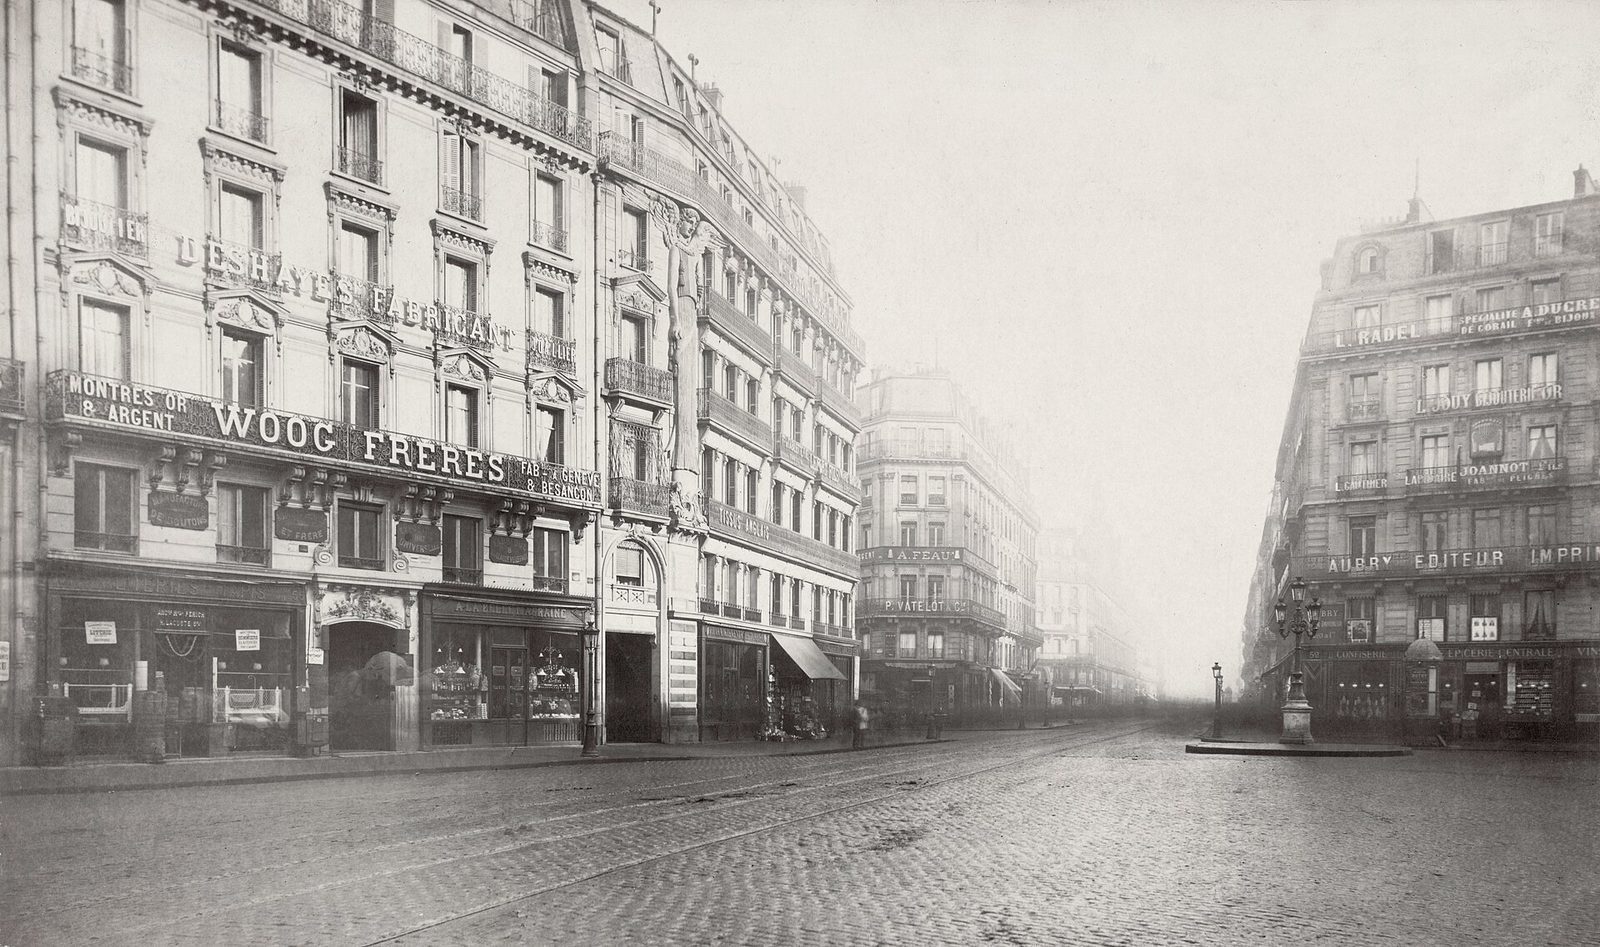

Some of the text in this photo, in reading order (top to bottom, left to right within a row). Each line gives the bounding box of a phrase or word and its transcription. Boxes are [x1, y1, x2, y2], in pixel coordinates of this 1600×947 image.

[180, 233, 352, 305] DESHAYES
[372, 286, 516, 351] FABRICANT
[1358, 324, 1420, 345] RADEL
[70, 375, 188, 414] MONTRES OR
[82, 400, 175, 432] & ARGENT
[210, 401, 504, 482] WOOG FRERES
[527, 478, 535, 492] &
[1327, 555, 1392, 574] AUBRY
[1414, 550, 1505, 570] EDITEUR
[897, 601, 944, 612] VATELOT
